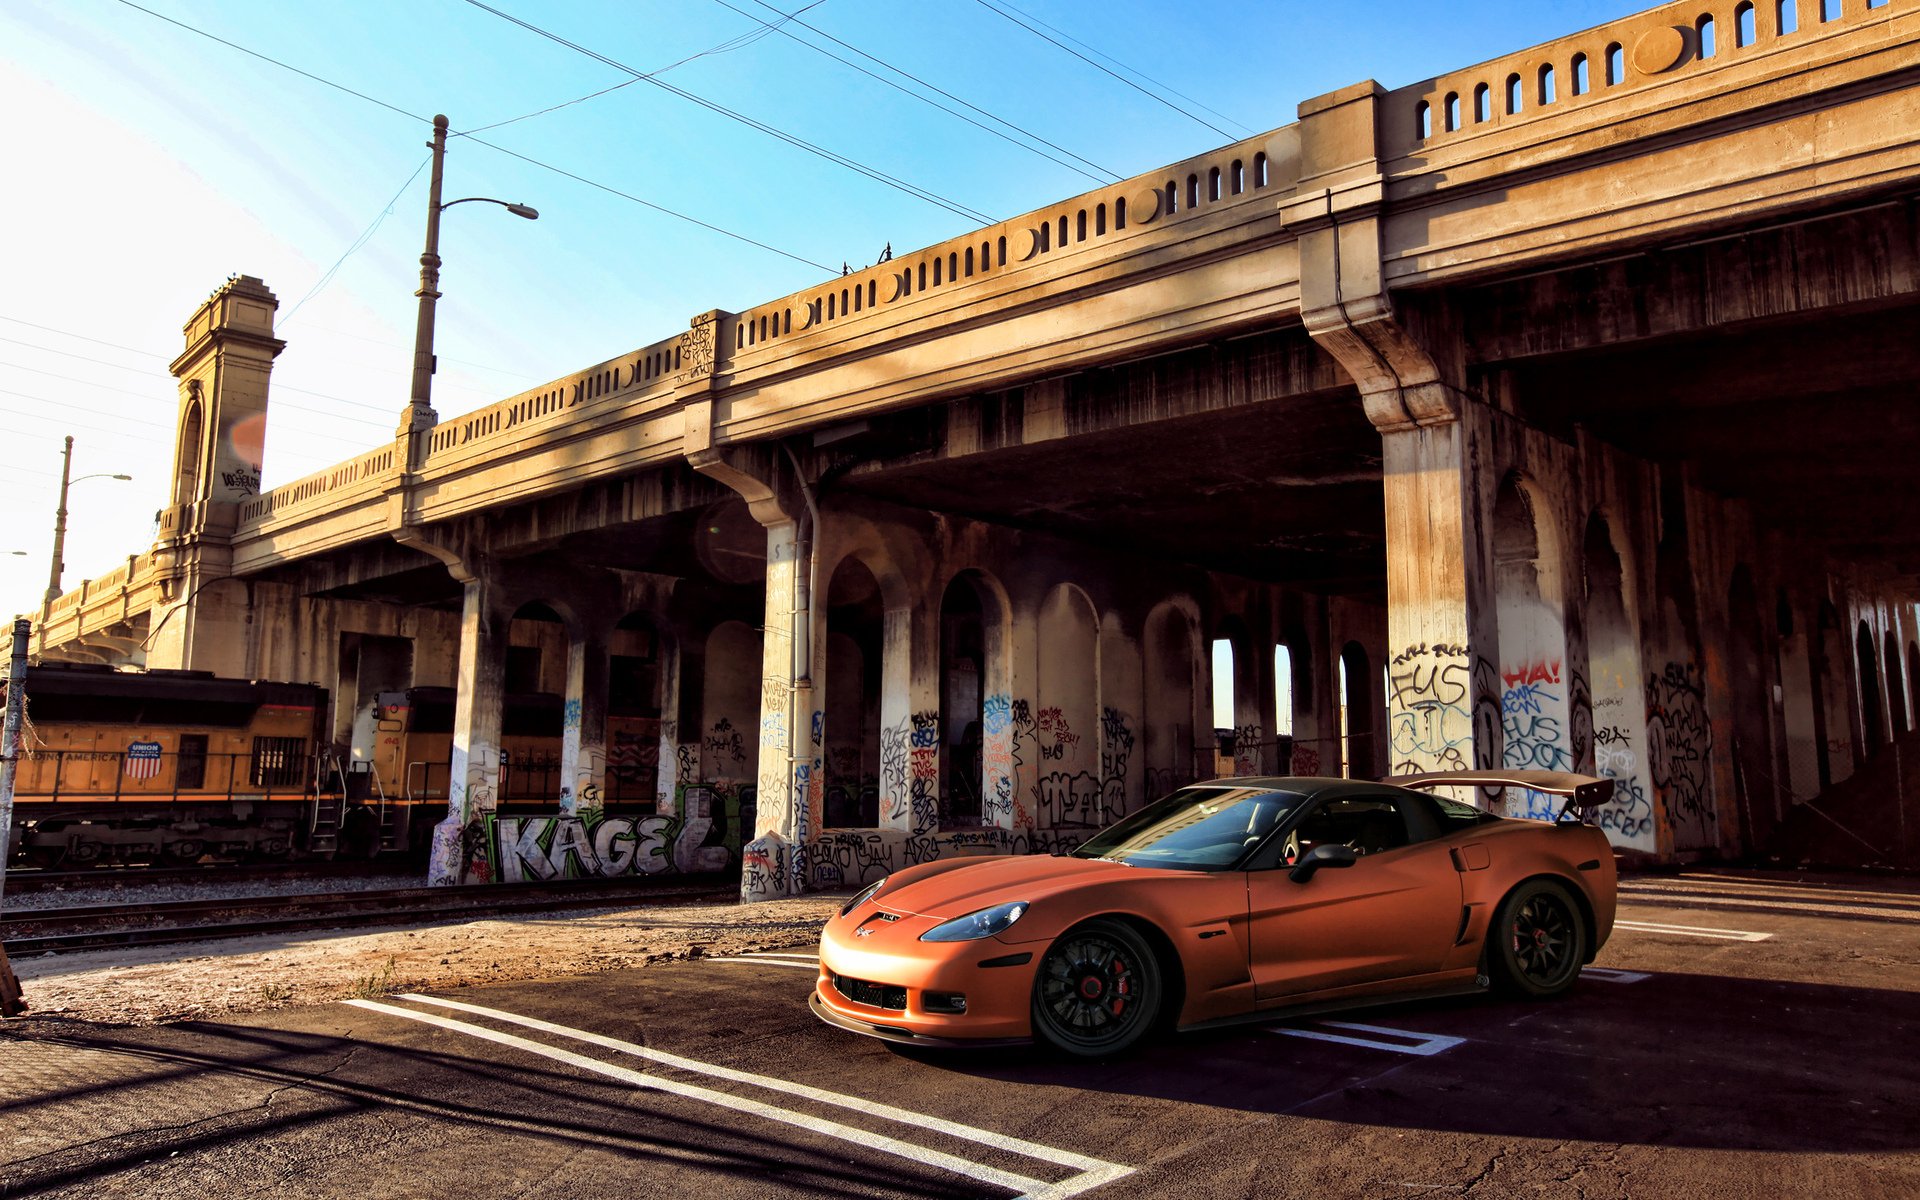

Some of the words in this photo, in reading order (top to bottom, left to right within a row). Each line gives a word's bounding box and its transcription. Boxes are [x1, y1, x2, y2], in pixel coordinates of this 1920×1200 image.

[1501, 657, 1561, 689] HA!
[66, 752, 118, 762] AMERICA
[494, 785, 733, 883] KAGEL
